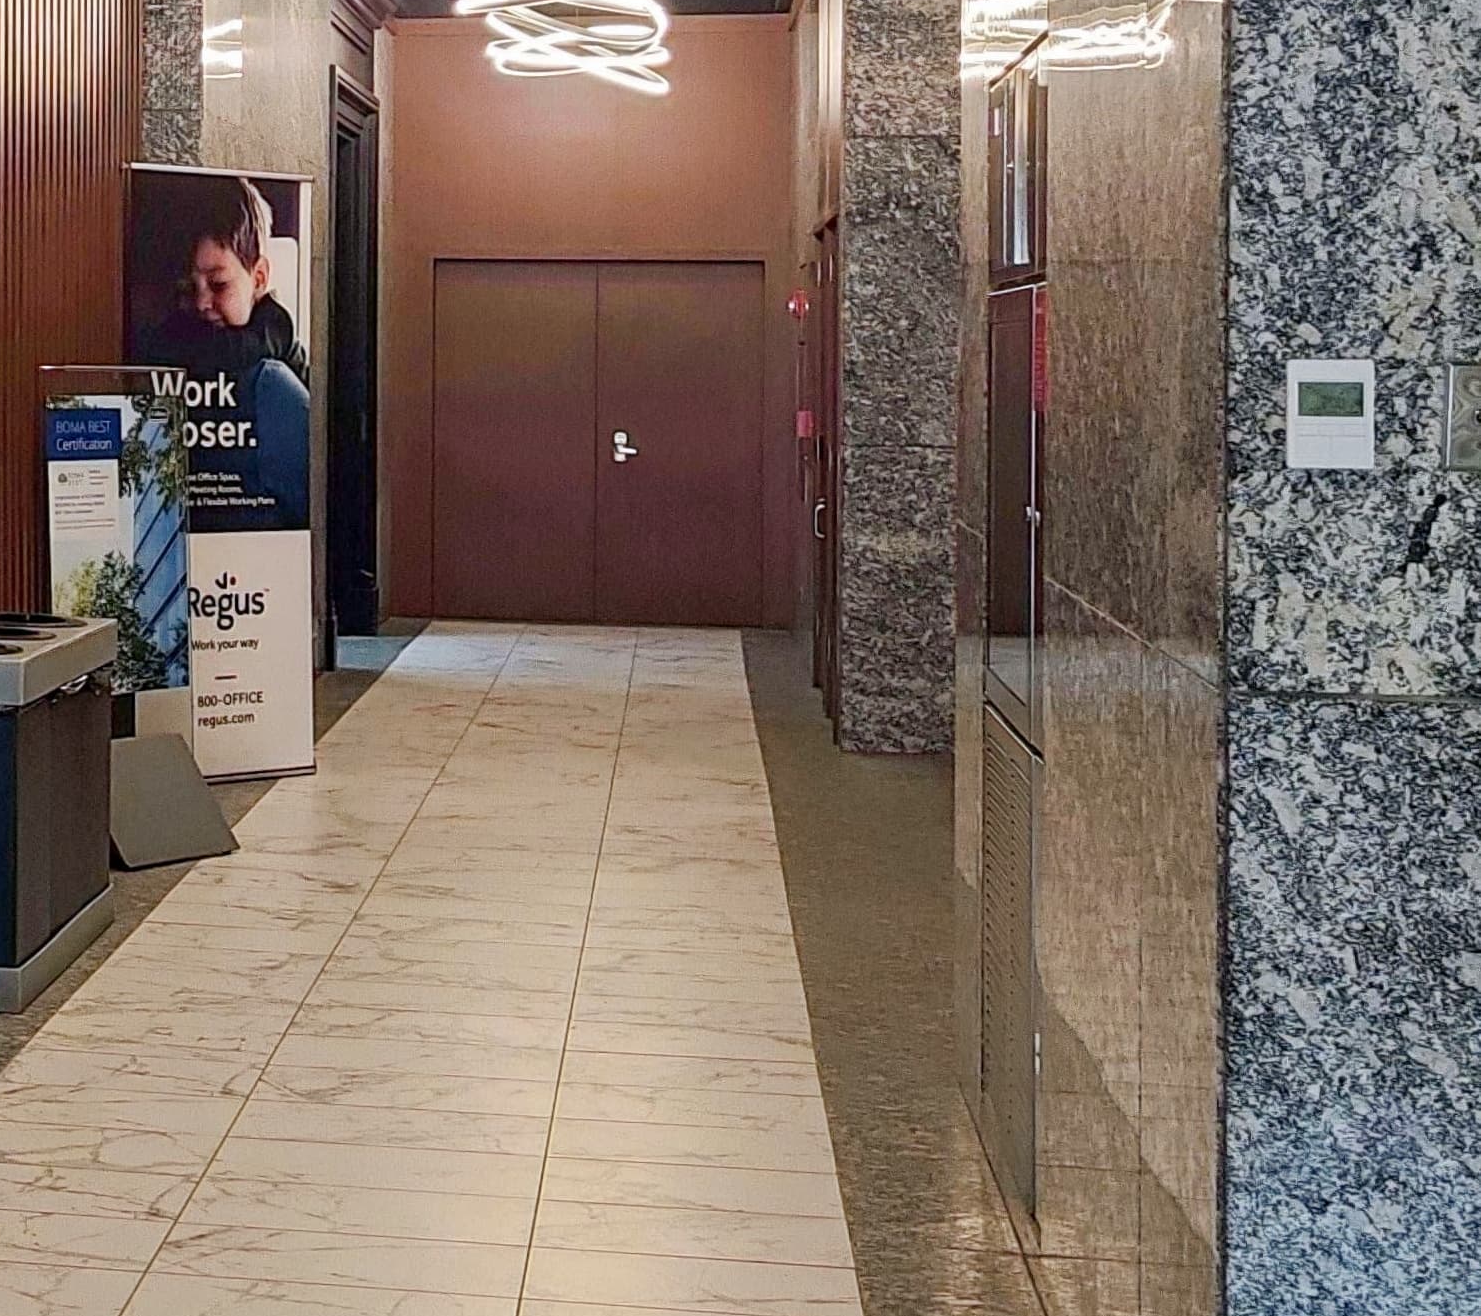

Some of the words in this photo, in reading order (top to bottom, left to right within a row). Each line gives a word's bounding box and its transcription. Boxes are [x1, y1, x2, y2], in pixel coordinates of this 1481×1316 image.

[151, 371, 236, 407] Work
[56, 420, 87, 433] BOMA
[88, 420, 111, 433] BEST
[183, 421, 257, 448] oser.
[56, 438, 112, 451] Certification
[187, 587, 265, 631] Regus
[191, 639, 216, 651] Work
[217, 640, 238, 652] your
[240, 639, 259, 650] way
[197, 691, 264, 708] 800-OFFICE
[198, 713, 255, 729] regus.com
